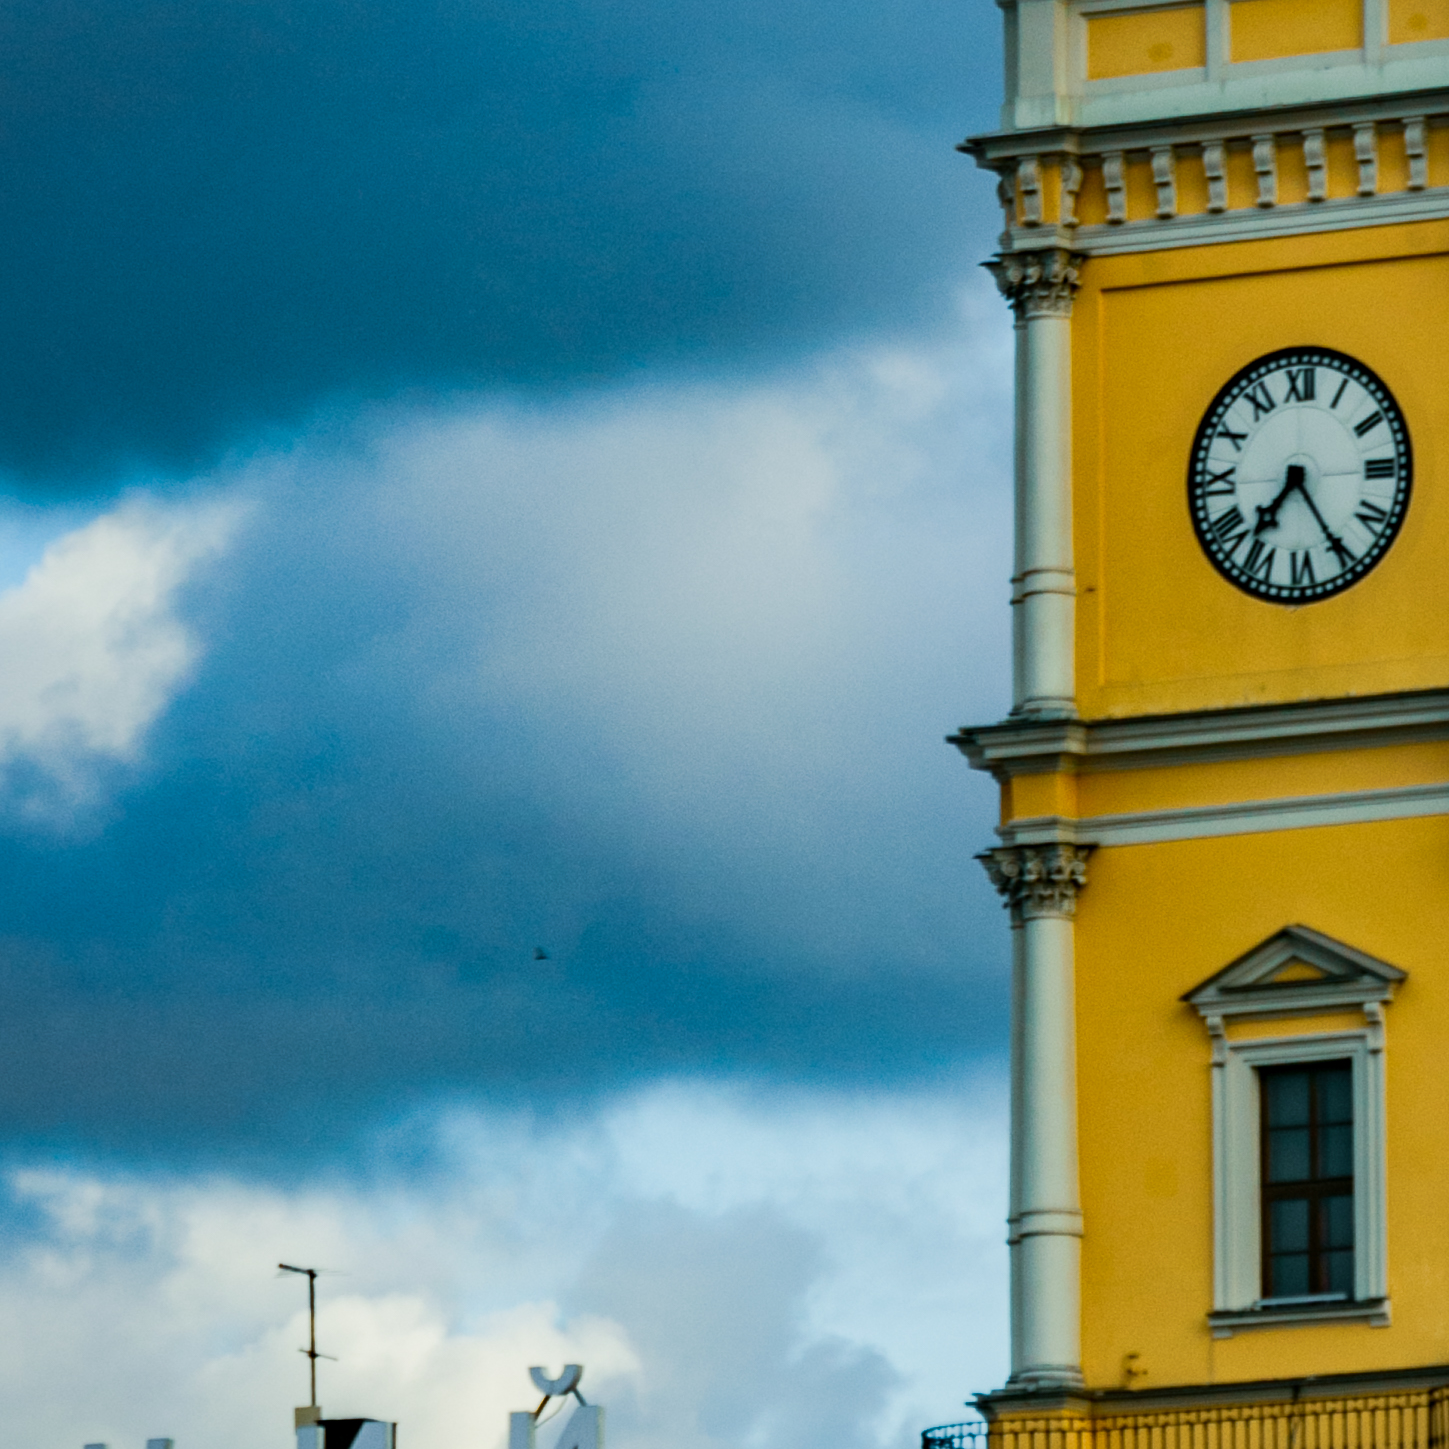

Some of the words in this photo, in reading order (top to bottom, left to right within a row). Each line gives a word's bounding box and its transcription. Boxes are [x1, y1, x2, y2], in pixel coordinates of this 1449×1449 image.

[1284, 368, 1316, 403] XII
[1330, 378, 1349, 409] I
[1243, 381, 1276, 422] XI
[1215, 421, 1249, 451] X
[1353, 410, 1384, 438] II
[1205, 466, 1236, 496] IX
[1364, 458, 1395, 480] III
[1290, 551, 1315, 585] VI
